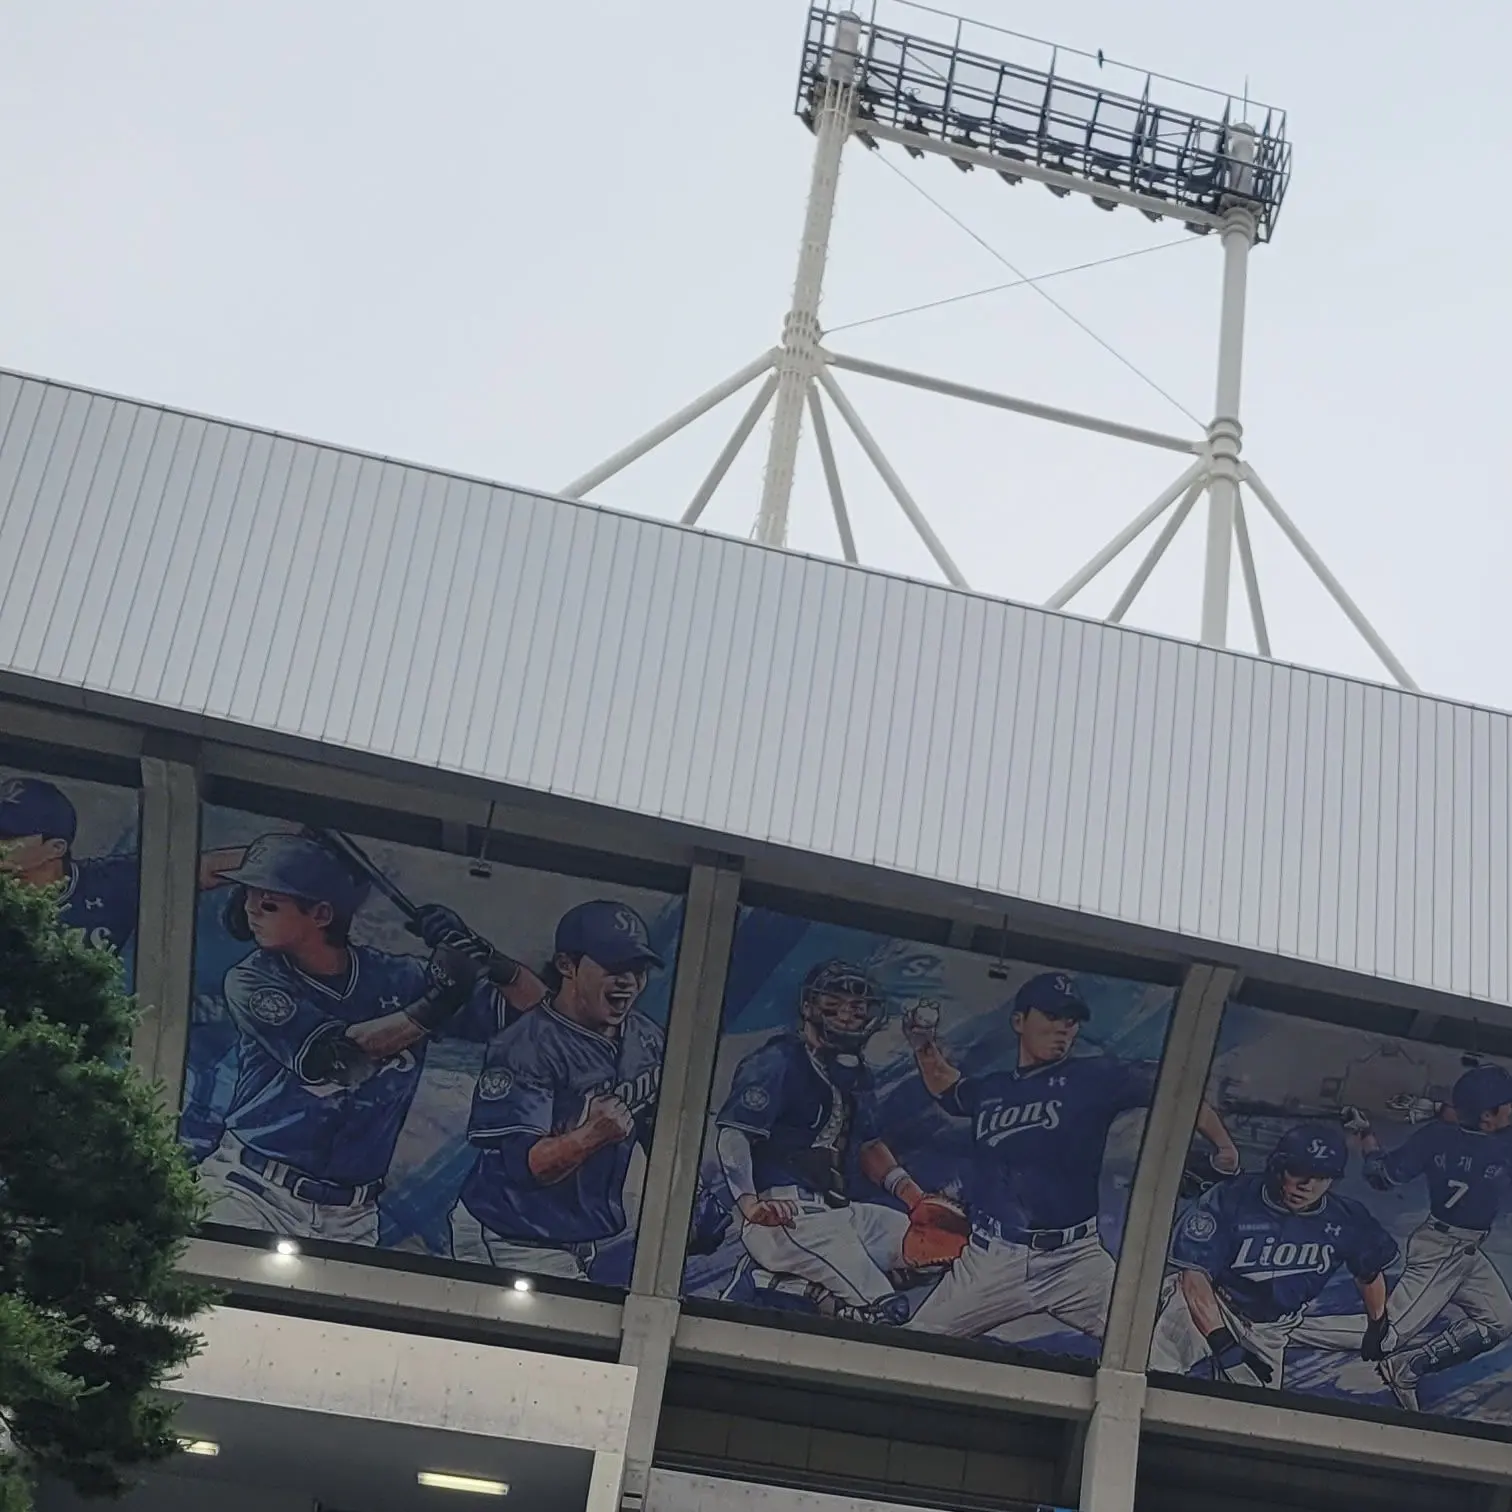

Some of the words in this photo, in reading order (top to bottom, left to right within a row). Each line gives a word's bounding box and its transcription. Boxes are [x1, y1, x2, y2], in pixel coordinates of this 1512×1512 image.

[976, 1099, 1063, 1140] Lions
[1443, 1178, 1469, 1209] 7
[1230, 1236, 1336, 1275] Lions
